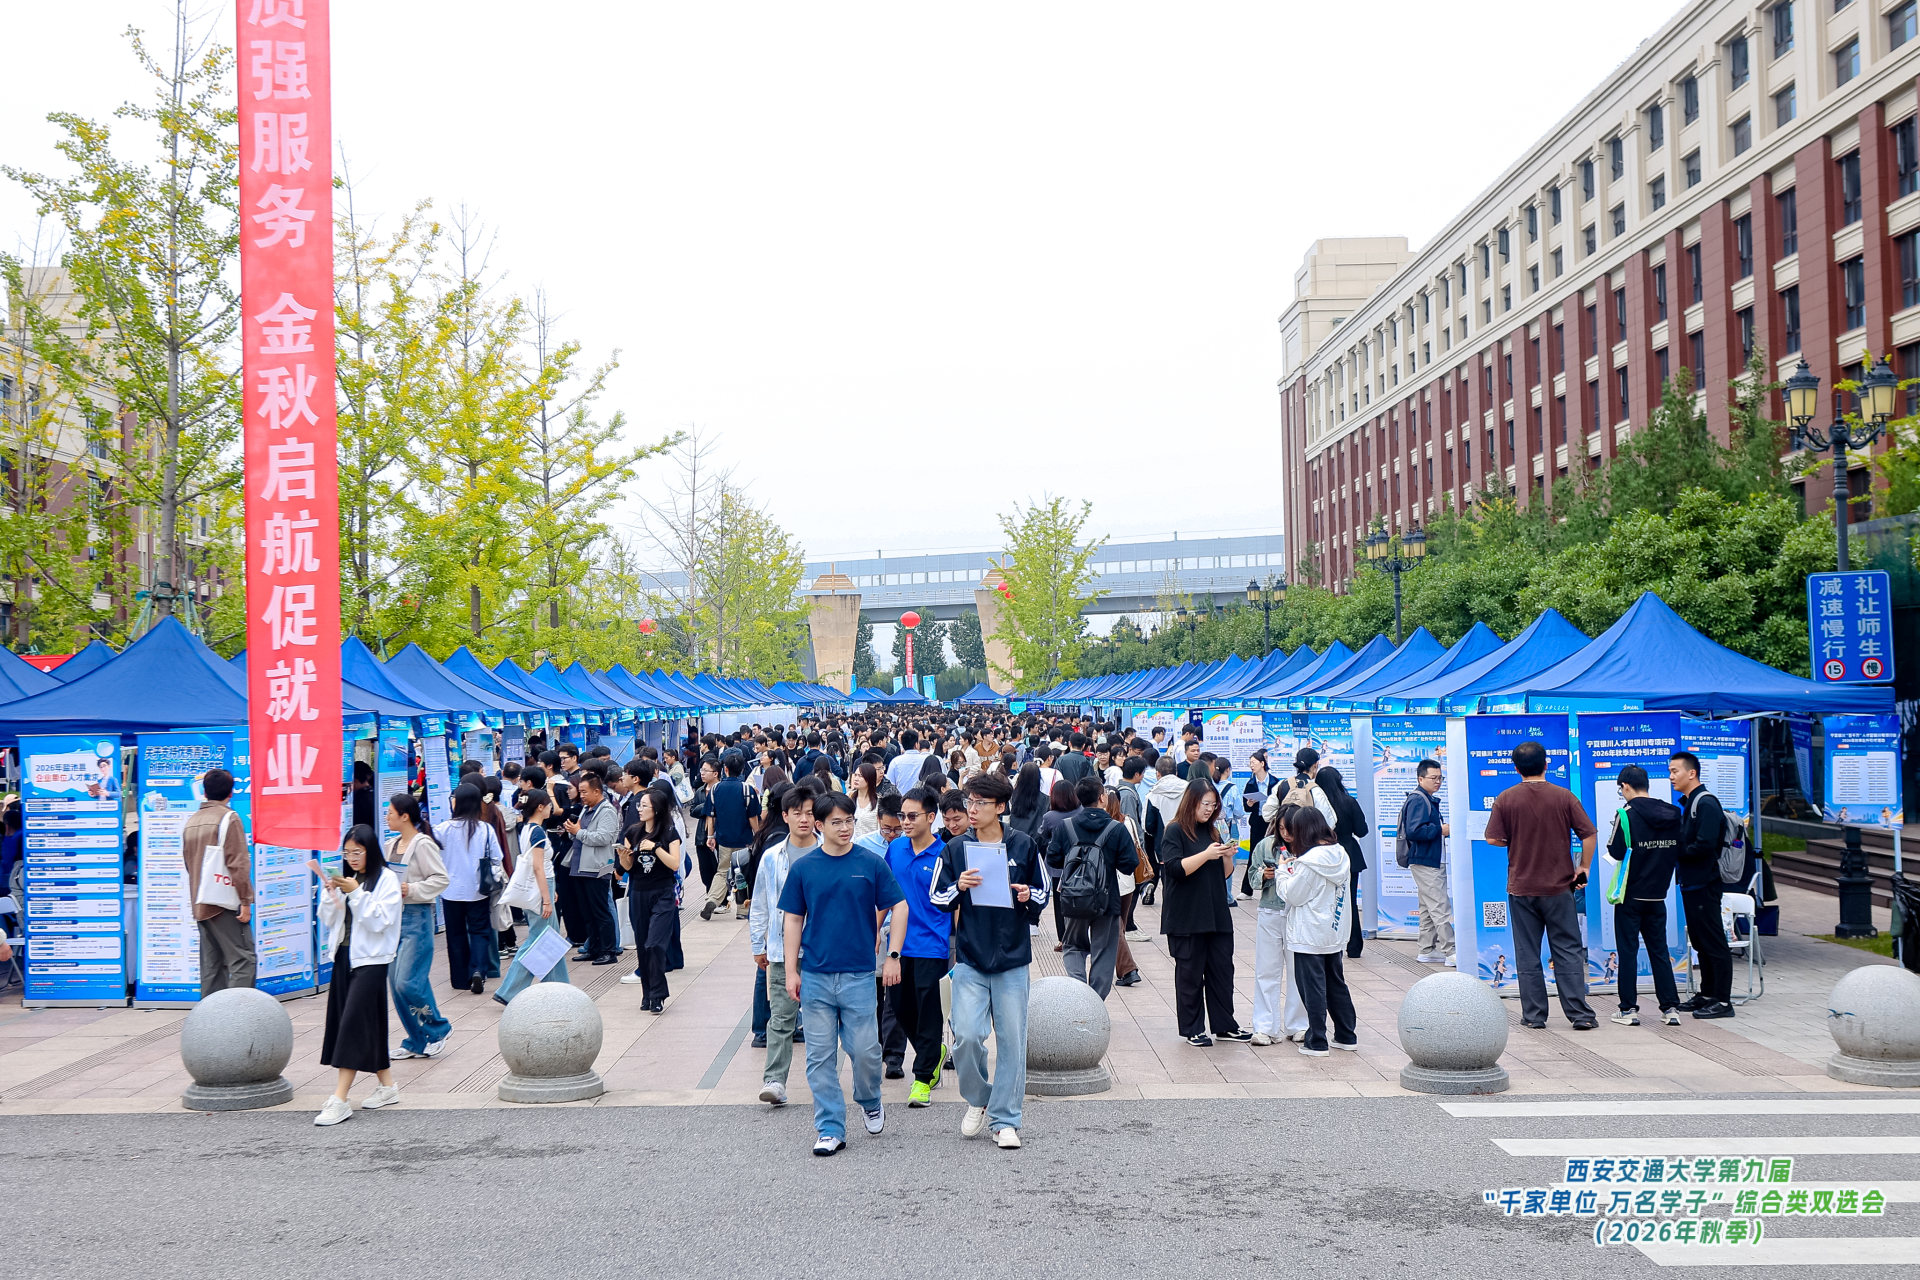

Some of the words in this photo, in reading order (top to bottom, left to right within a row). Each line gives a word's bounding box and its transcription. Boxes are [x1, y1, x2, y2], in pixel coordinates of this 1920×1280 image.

[254, 292, 323, 796] 金秋启航促就业
[1818, 577, 1846, 659] 减速慢行
[1854, 576, 1883, 657] 礼让师生
[1828, 664, 1842, 675] 15
[1866, 662, 1879, 674] 慢
[1591, 747, 1671, 757] 2026年秋季赴外引才活动
[214, 873, 236, 887] TC
